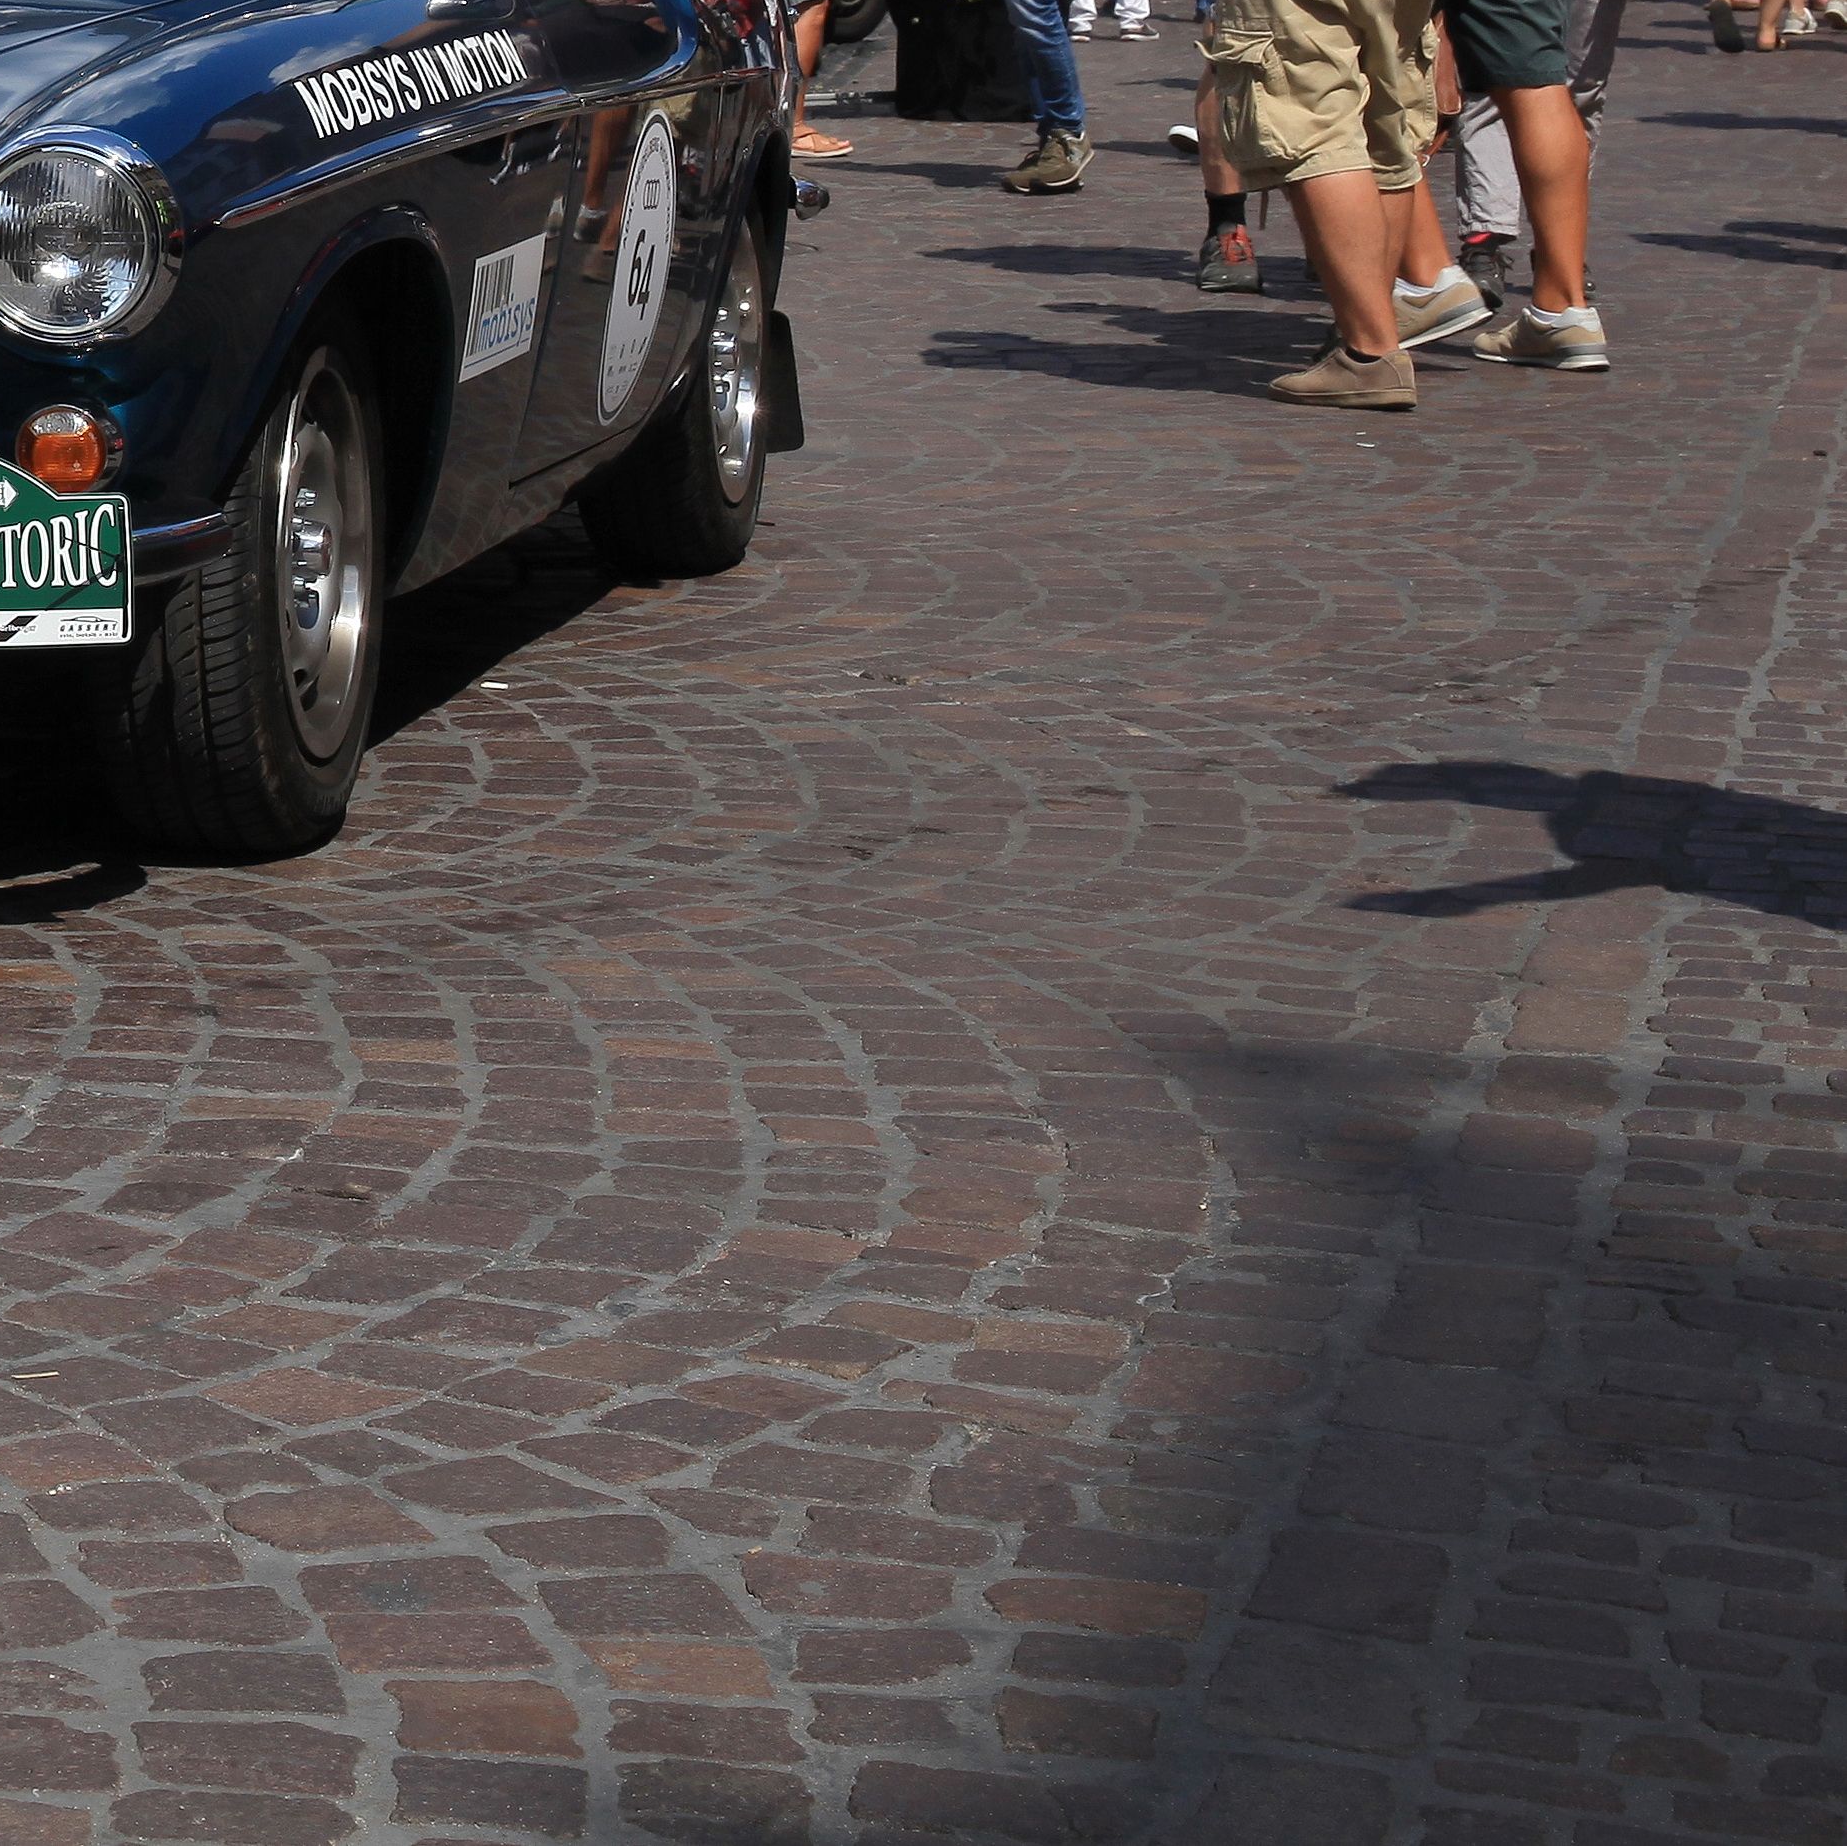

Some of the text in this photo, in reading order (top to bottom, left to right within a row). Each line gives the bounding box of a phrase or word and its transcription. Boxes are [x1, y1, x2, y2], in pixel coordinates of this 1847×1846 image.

[293, 28, 529, 139] MOBISYS IN MOTION
[480, 292, 536, 349] mobisys
[628, 228, 656, 321] 64
